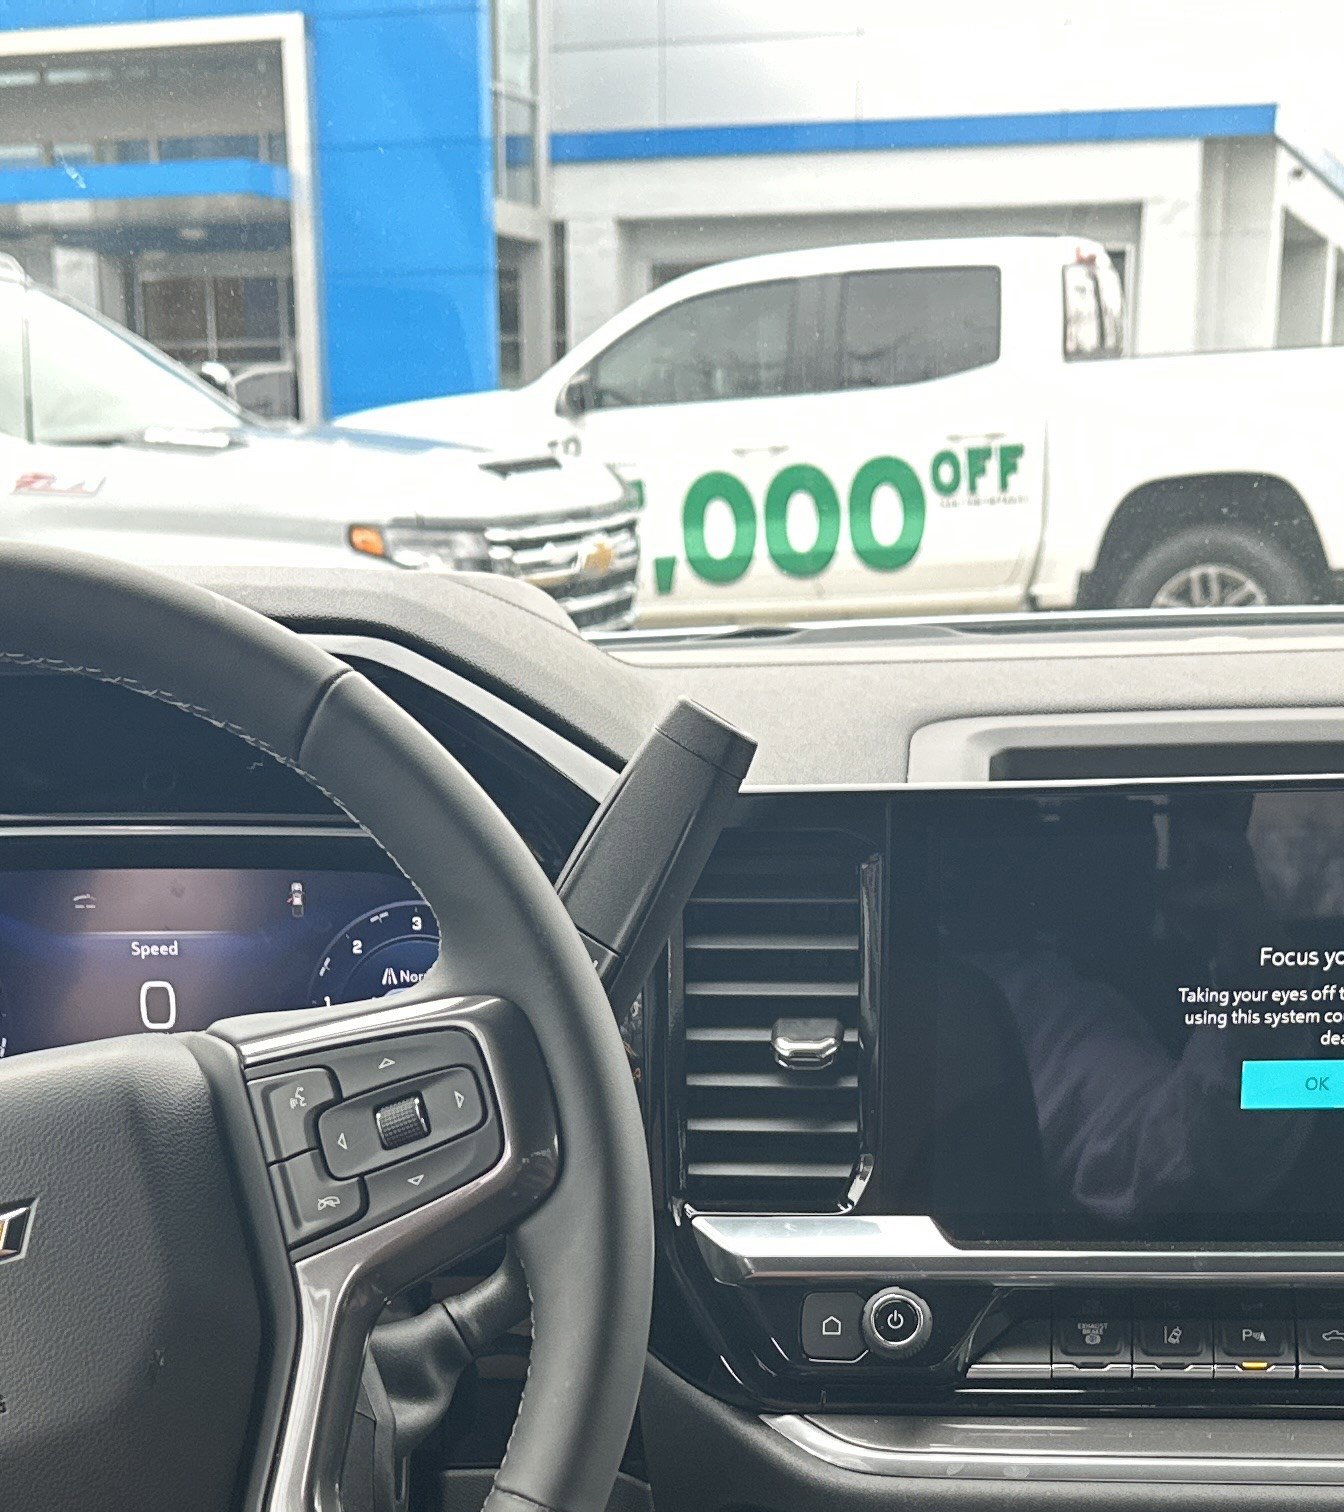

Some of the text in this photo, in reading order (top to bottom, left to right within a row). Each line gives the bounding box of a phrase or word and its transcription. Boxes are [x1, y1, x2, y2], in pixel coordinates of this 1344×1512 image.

[630, 443, 1024, 596] ,000 OFF
[412, 916, 423, 931] 3
[131, 940, 179, 959] Speed
[352, 939, 363, 954] 2
[1260, 946, 1320, 967] Focus
[400, 969, 424, 983] Nor
[140, 980, 177, 1030] 0
[1177, 986, 1230, 1007] Taking
[1232, 990, 1269, 1007] your
[1271, 989, 1308, 1006] eyes
[1310, 984, 1337, 1001] off
[1184, 1009, 1228, 1029] using
[1231, 1008, 1261, 1025] this
[1263, 1009, 1321, 1029] system
[1305, 1076, 1330, 1091] OK
